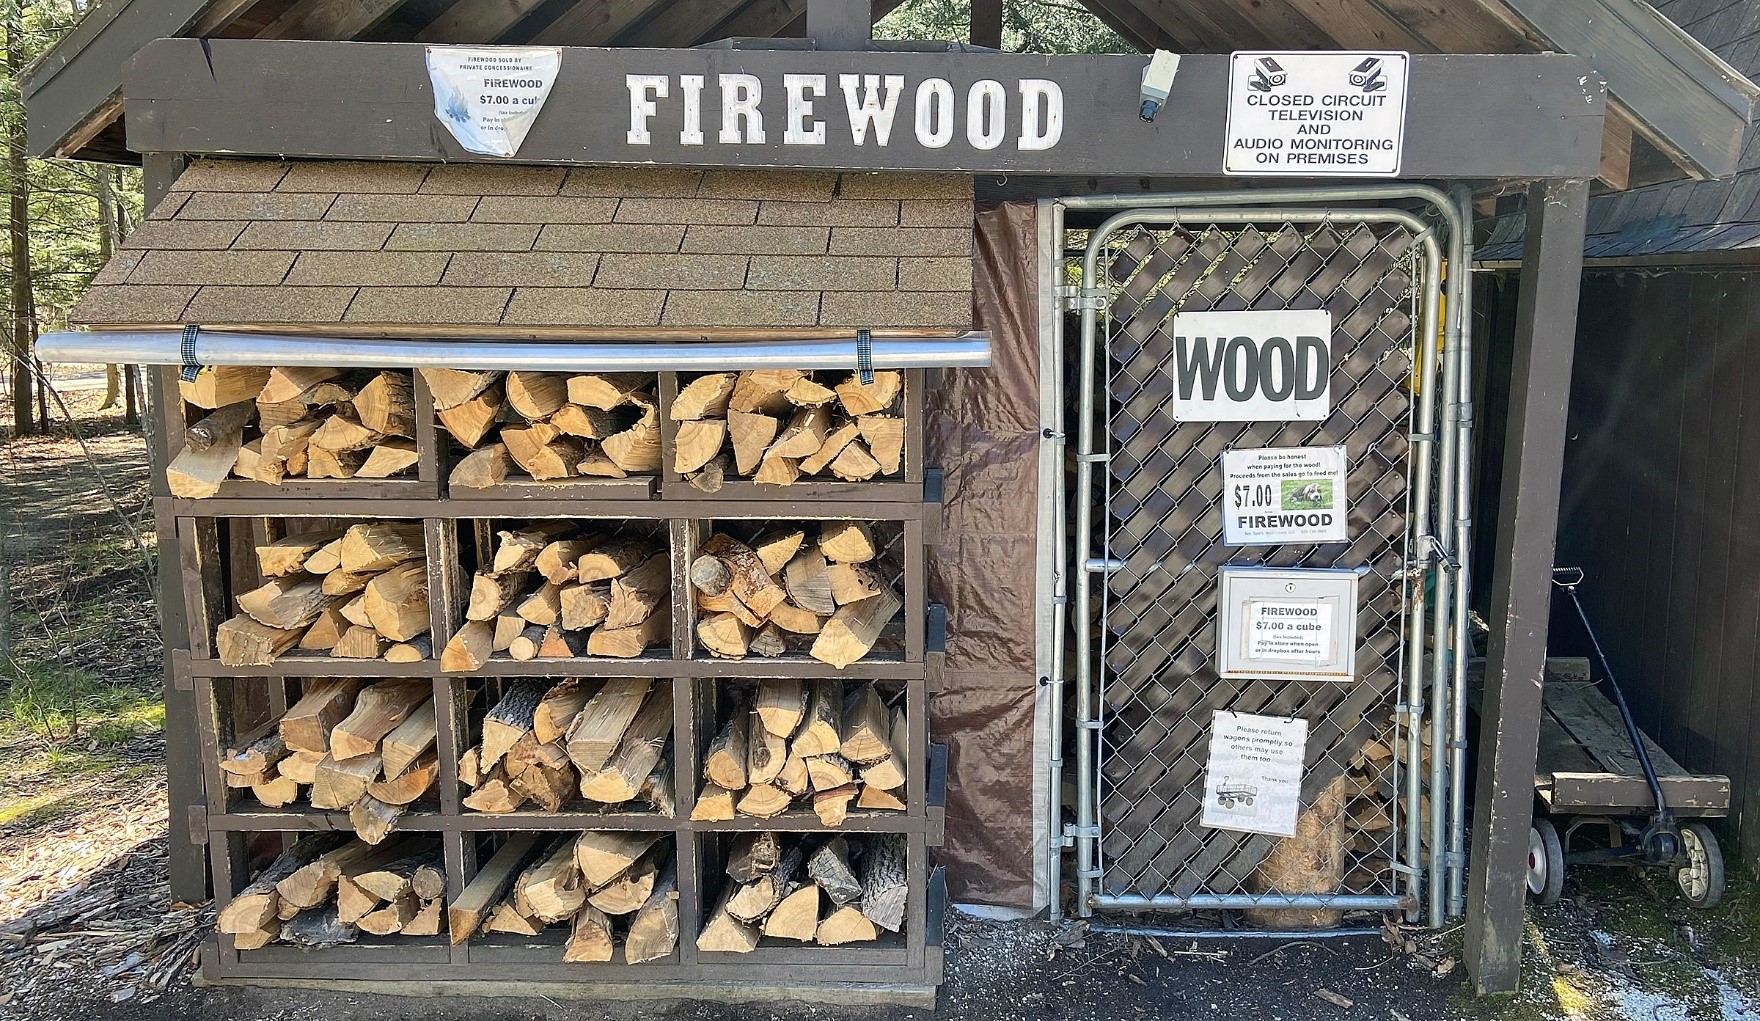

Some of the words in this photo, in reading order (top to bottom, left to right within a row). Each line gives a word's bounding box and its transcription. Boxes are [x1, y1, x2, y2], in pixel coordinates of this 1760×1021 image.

[484, 78, 543, 88] FIREWOOD
[480, 94, 509, 104] $7.00
[1246, 94, 1314, 106] CLOSED
[1322, 94, 1386, 106] CIRCUIT
[625, 74, 1064, 150] FIREWOOD
[1268, 110, 1364, 121] TELEVISION
[1296, 124, 1331, 135] AND
[1234, 138, 1284, 149] AUDIO
[1290, 138, 1393, 150] MONITORING
[1256, 152, 1280, 164] ON
[1286, 153, 1369, 164] PREMISES
[1175, 336, 1330, 402] WOOD
[1234, 484, 1272, 510] $7.00
[1238, 513, 1333, 528] FIREWOOD
[1261, 607, 1318, 616] FIREWOOD
[1256, 621, 1284, 630] $7.00
[1296, 623, 1322, 631] cube
[1236, 726, 1259, 734] Please
[1251, 738, 1282, 746] promptly
